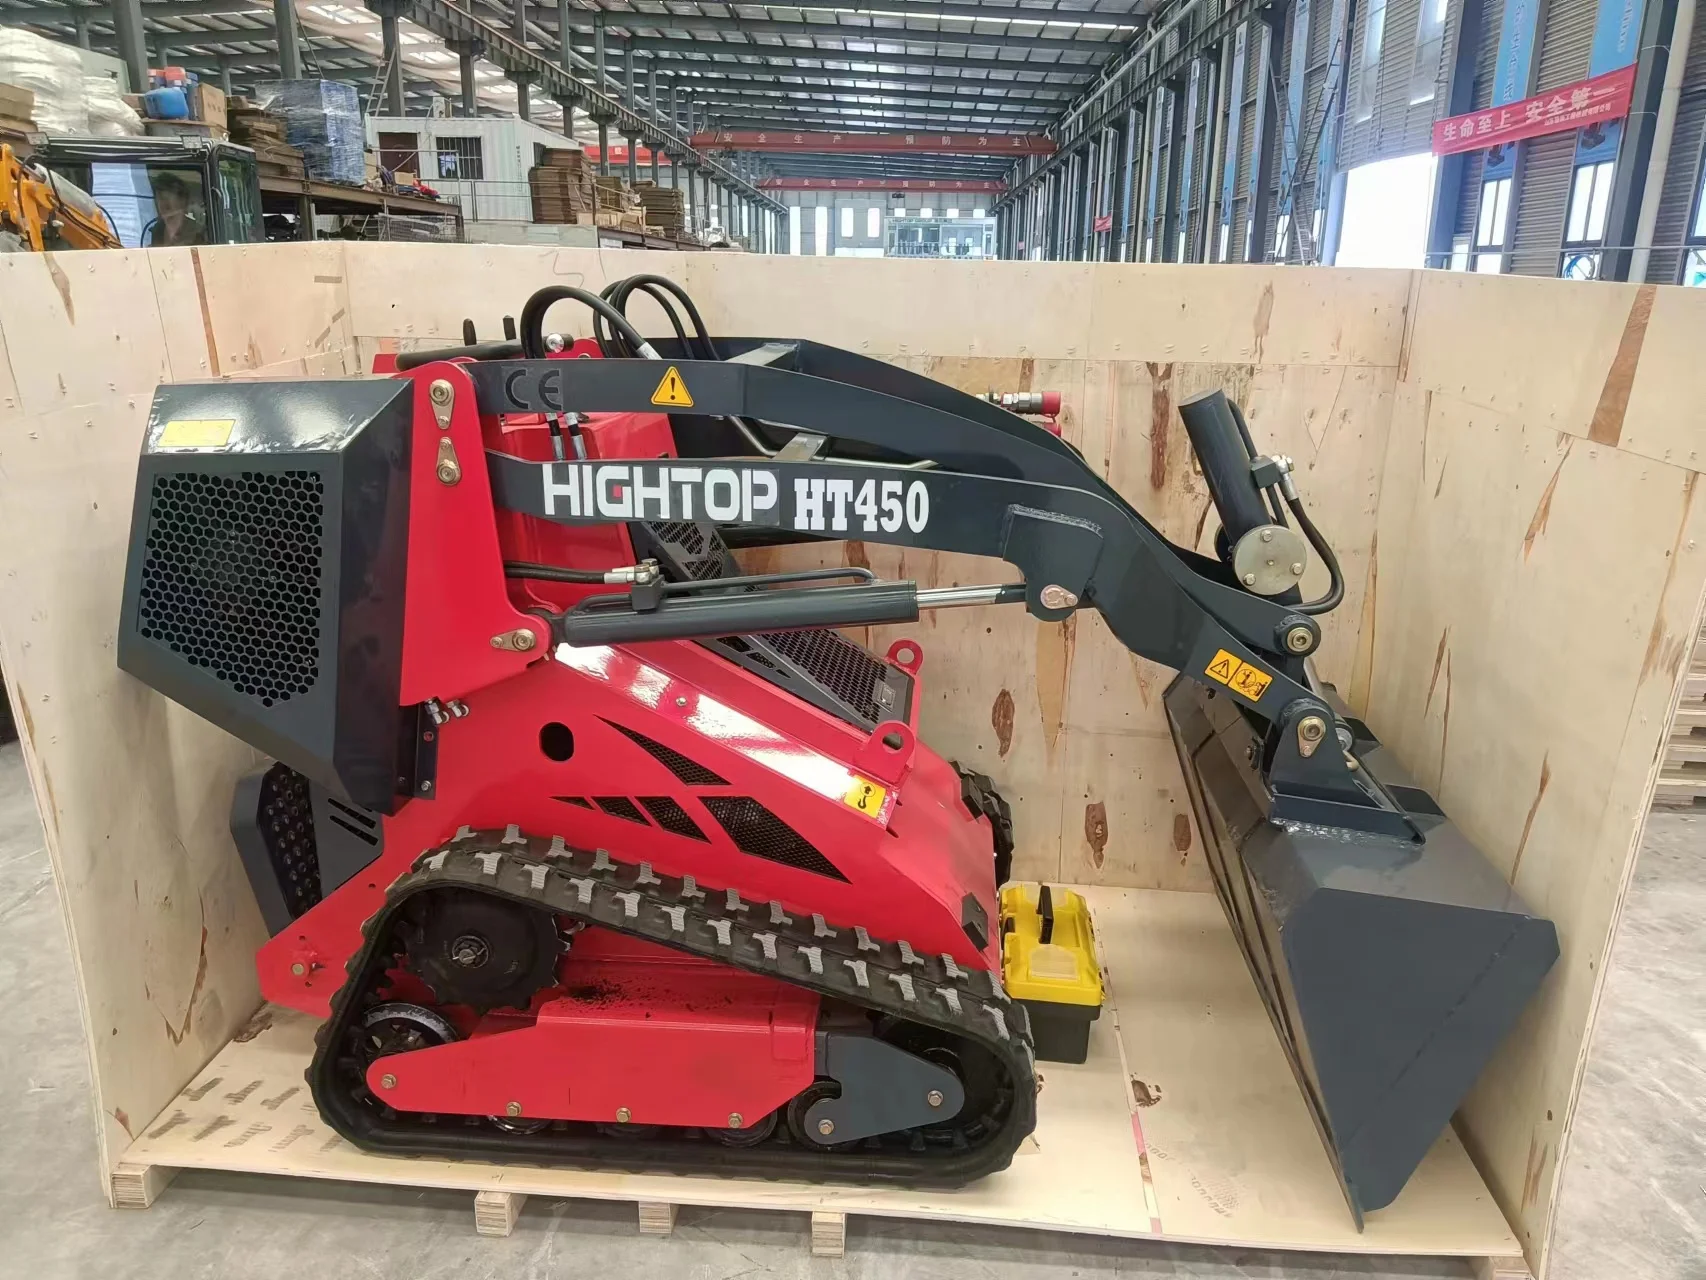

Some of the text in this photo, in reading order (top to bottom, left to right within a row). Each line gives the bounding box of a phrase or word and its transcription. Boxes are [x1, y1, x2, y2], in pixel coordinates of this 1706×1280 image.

[1443, 86, 1615, 142] 生命至上 安全第一
[723, 133, 1021, 147] 安全生产 预防为主
[505, 369, 562, 410] CE
[542, 463, 929, 534] HIGHTOP HT450
